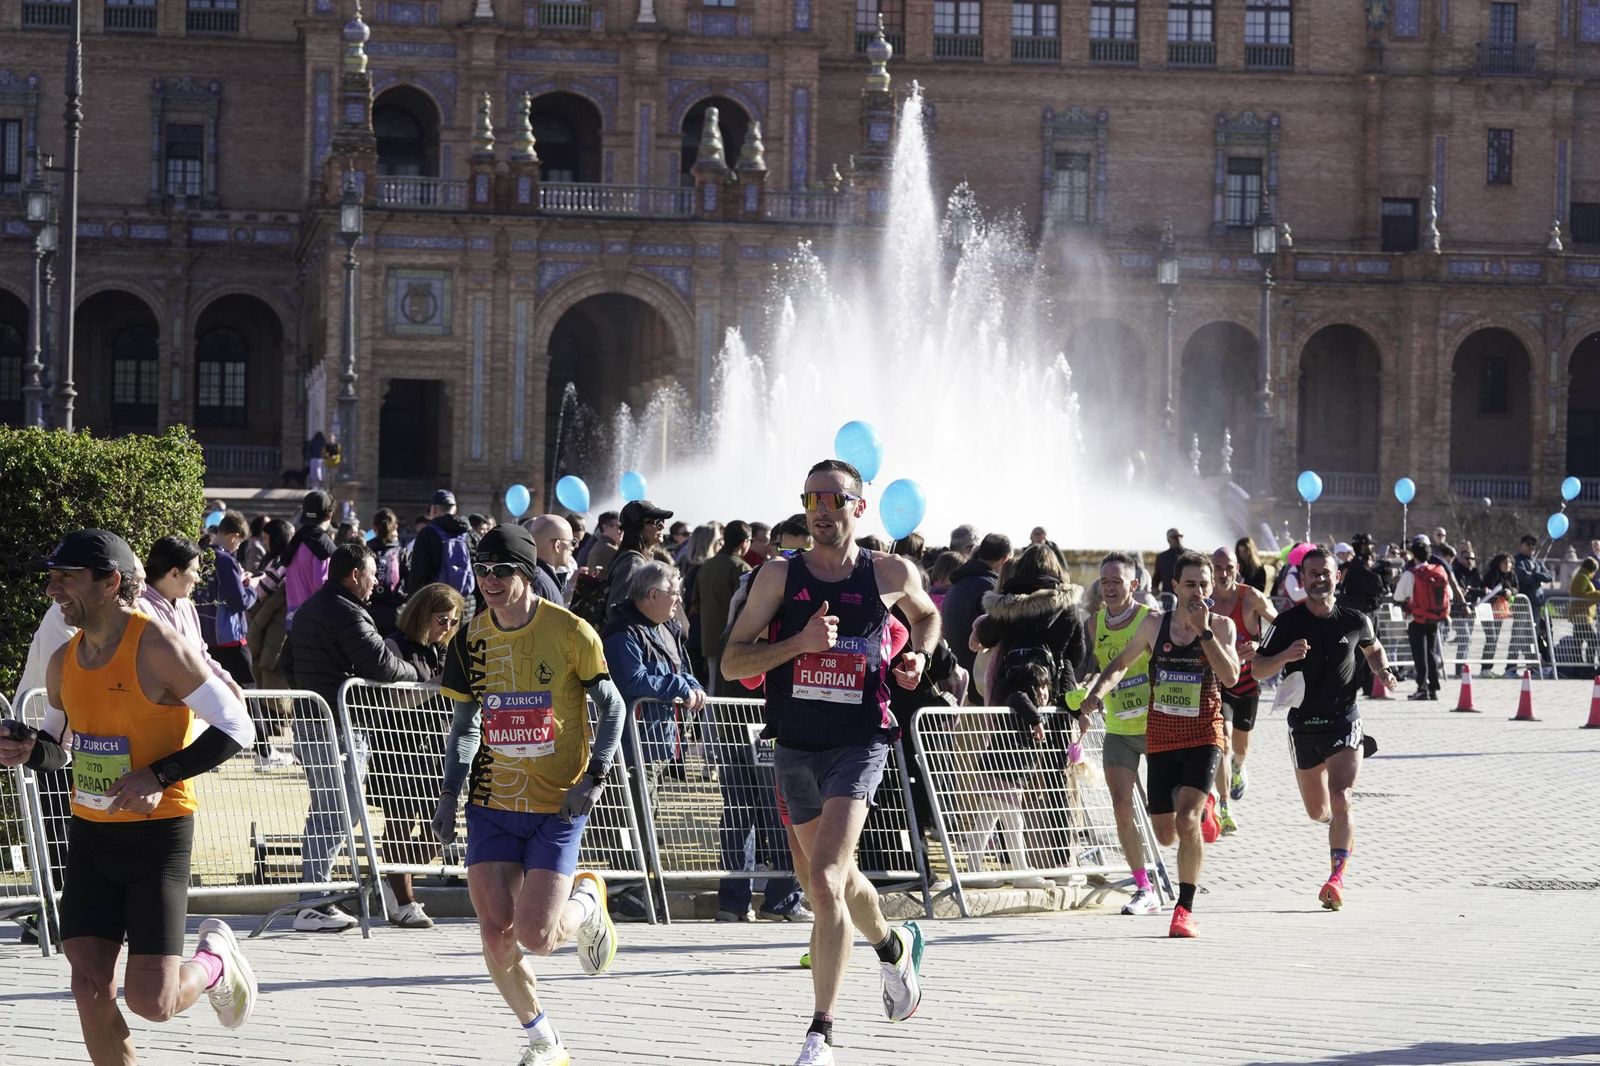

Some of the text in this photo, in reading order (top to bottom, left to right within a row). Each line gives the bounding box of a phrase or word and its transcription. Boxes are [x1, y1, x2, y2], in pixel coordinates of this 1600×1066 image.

[835, 641, 859, 649] RICH
[820, 658, 837, 668] 708
[801, 669, 856, 687] FLORIAN
[505, 696, 543, 706] ZURICH
[1122, 698, 1142, 709] LOLO
[1160, 694, 1191, 706] ARCOS
[510, 715, 526, 725] 779
[489, 727, 551, 743] MAURYCY
[83, 739, 119, 751] ZURICH
[86, 761, 103, 774] 3170
[78, 774, 119, 791] PARAD
